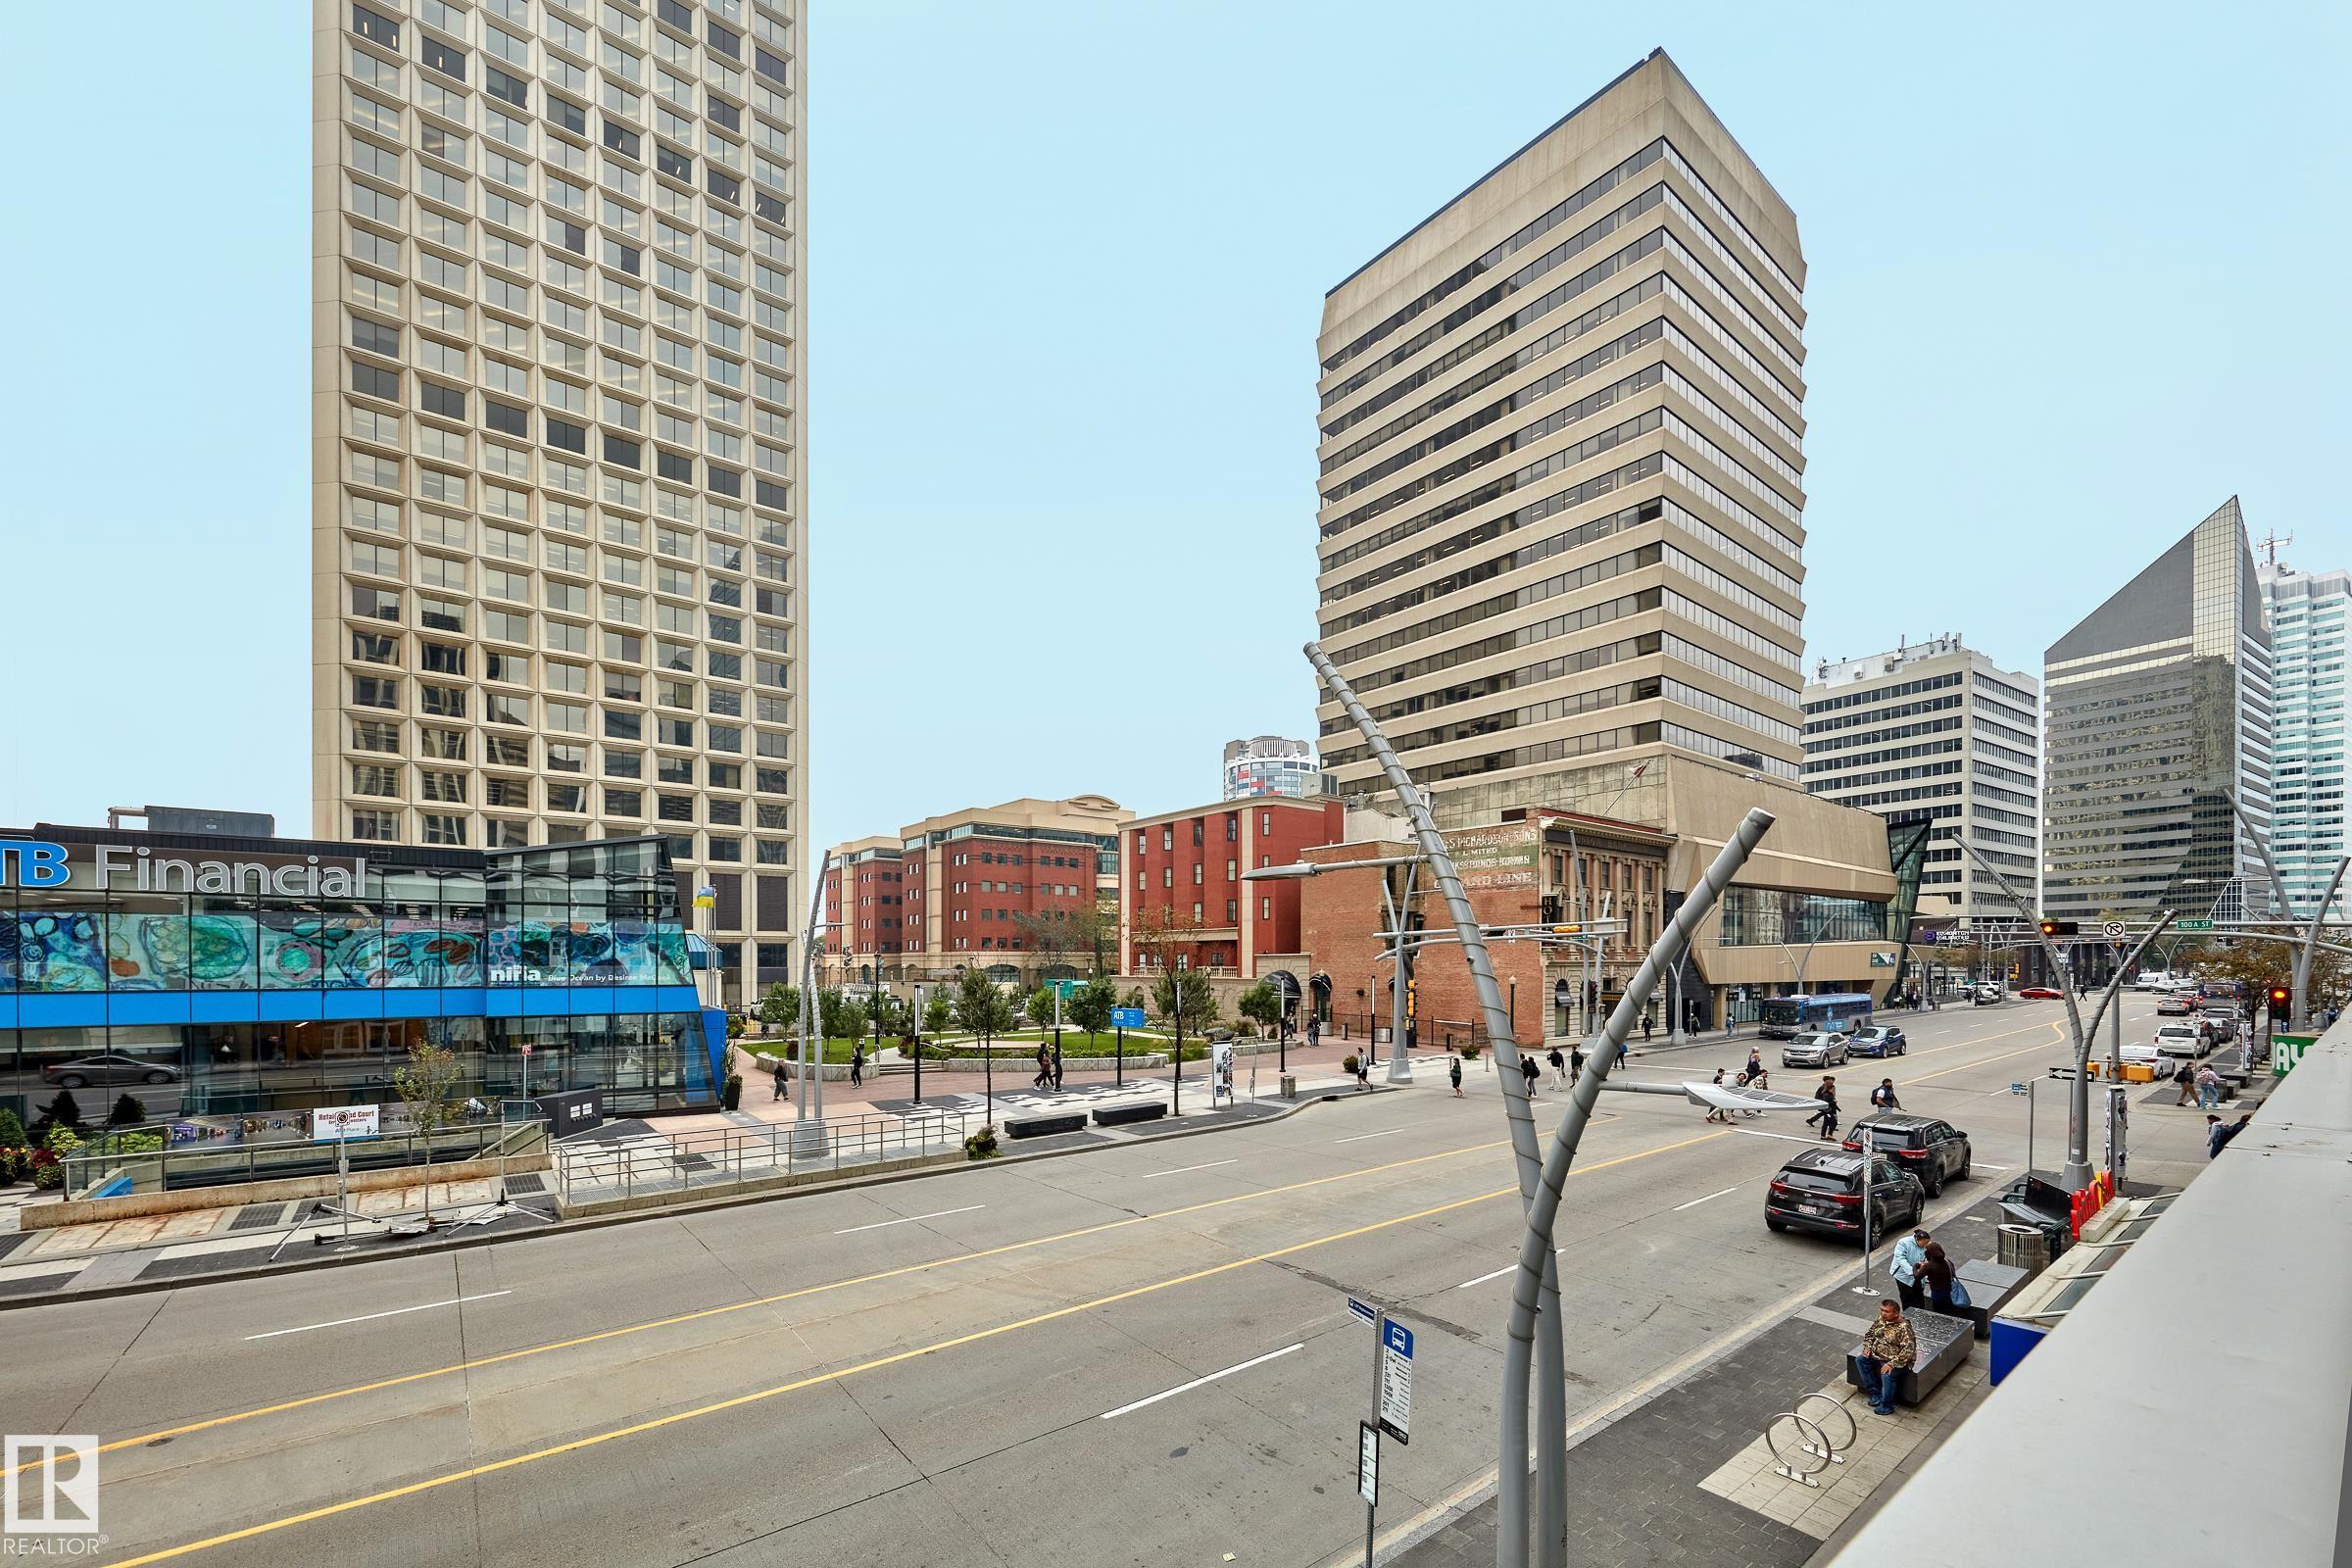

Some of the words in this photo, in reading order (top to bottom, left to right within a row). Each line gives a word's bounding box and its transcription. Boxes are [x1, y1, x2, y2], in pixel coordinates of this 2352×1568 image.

[96, 844, 367, 898] Financial
[1544, 897, 1552, 931] HOT
[596, 974, 606, 983] by
[1113, 1011, 1124, 1020] ATB
